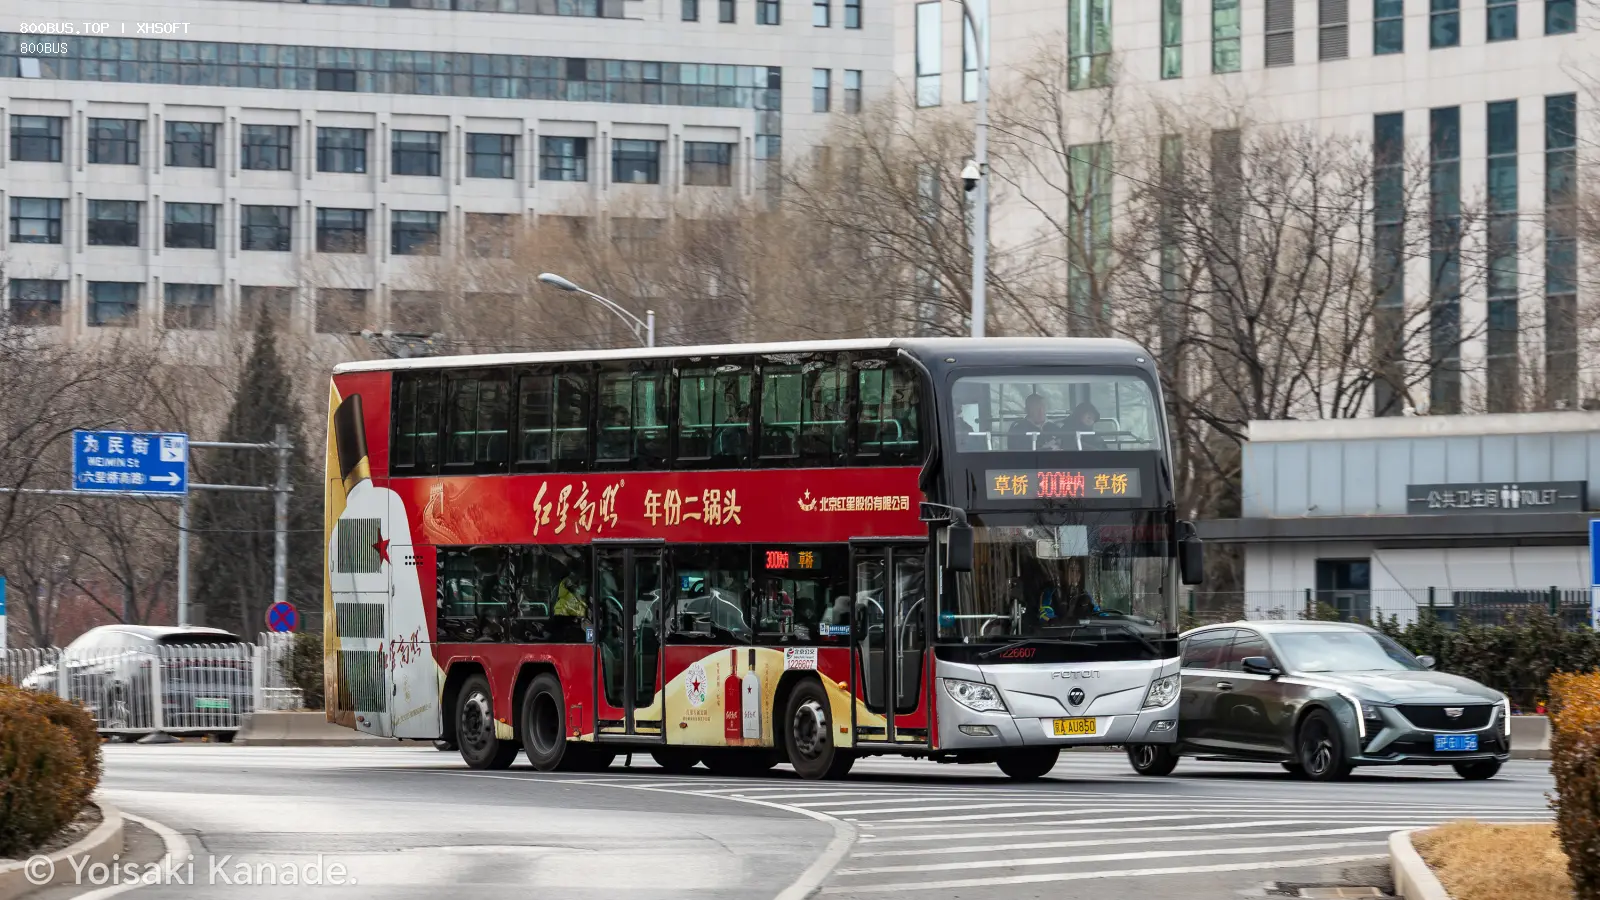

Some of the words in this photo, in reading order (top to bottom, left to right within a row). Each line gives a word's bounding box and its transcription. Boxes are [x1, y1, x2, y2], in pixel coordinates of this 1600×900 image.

[83, 434, 150, 455] 为民街
[993, 474, 1028, 496] 草桥
[1094, 473, 1128, 495] 草桥
[643, 488, 742, 527] 年份二锅头
[819, 495, 910, 512] 北京红星股份有限公司
[1427, 488, 1500, 508] 公共卫生间
[798, 551, 814, 569] 草桥
